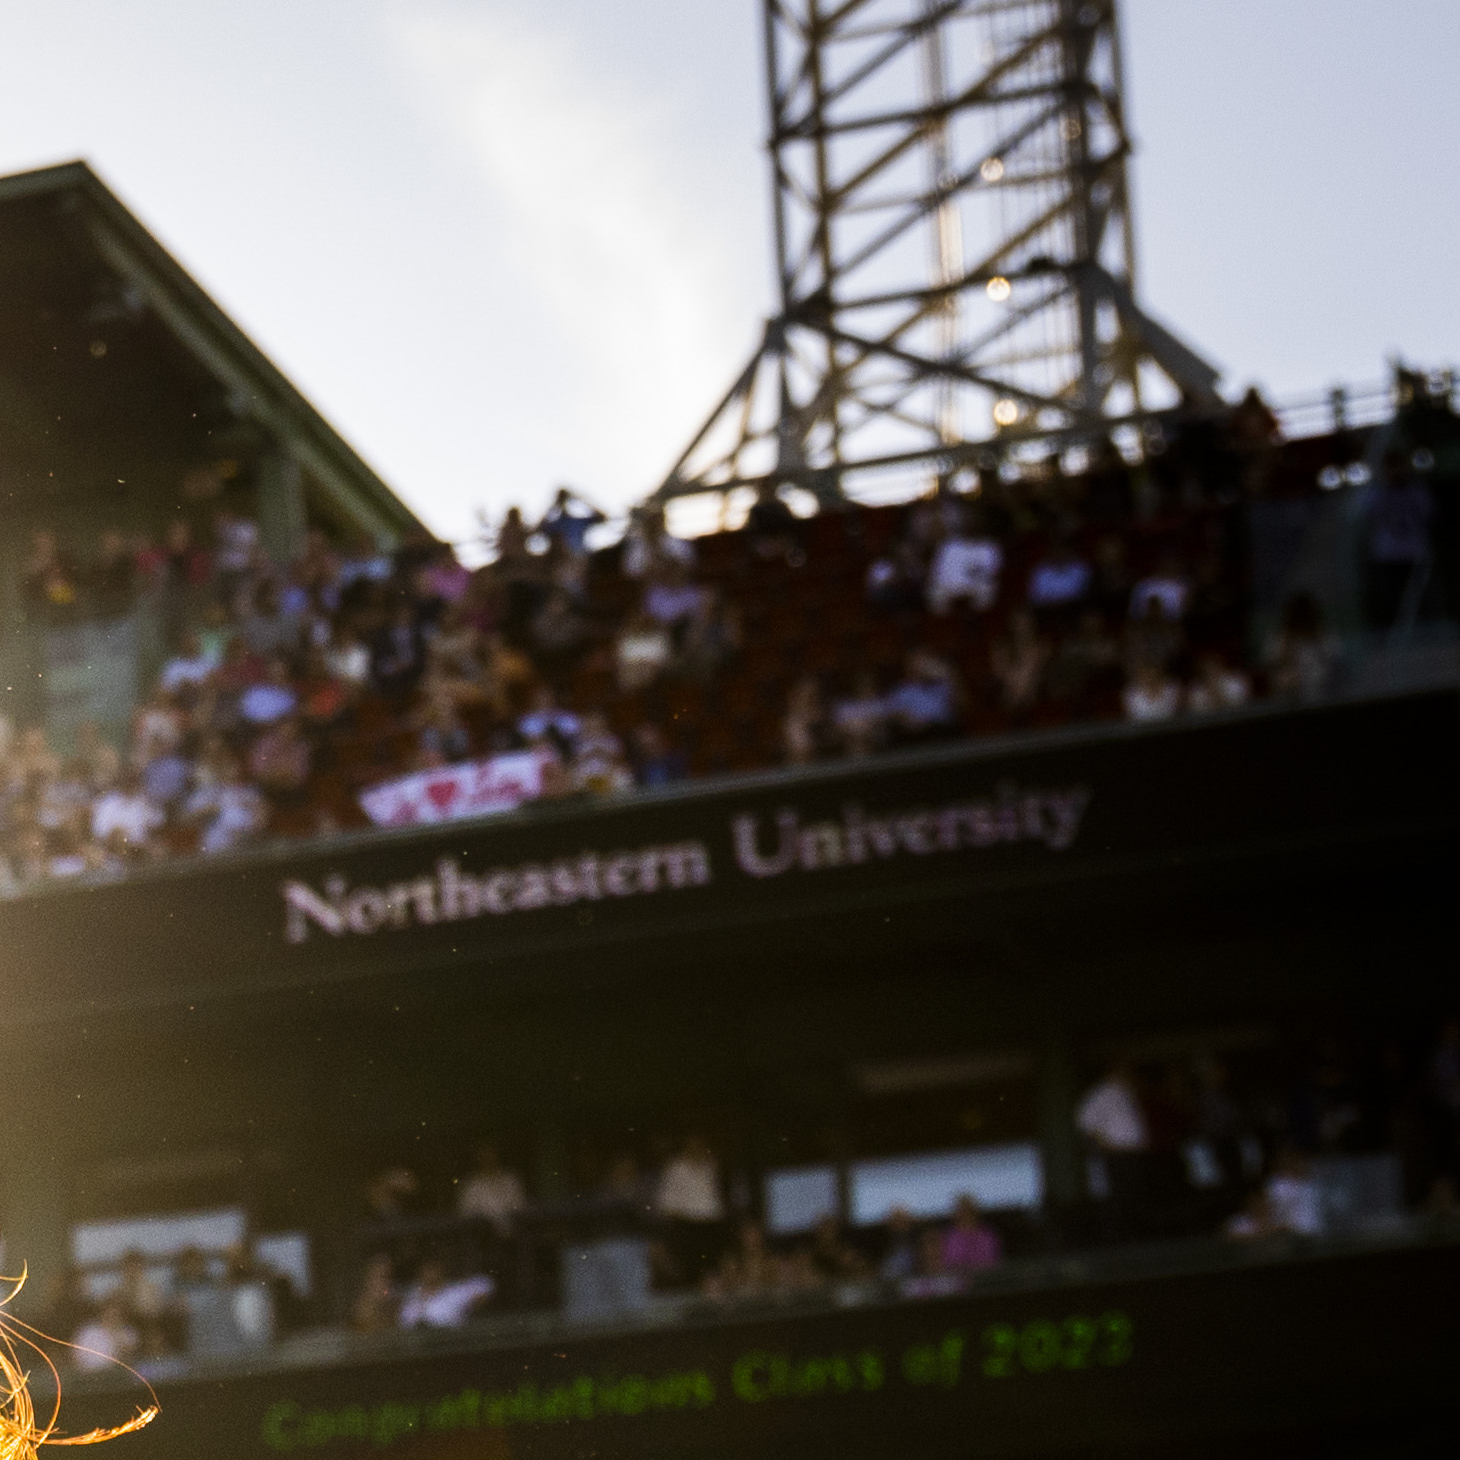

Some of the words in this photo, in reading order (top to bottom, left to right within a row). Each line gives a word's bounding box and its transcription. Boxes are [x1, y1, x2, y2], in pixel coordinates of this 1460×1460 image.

[283, 838, 709, 943] Northeastern
[731, 785, 1084, 880] University
[731, 1344, 884, 1402] Class
[901, 1327, 965, 1389] of
